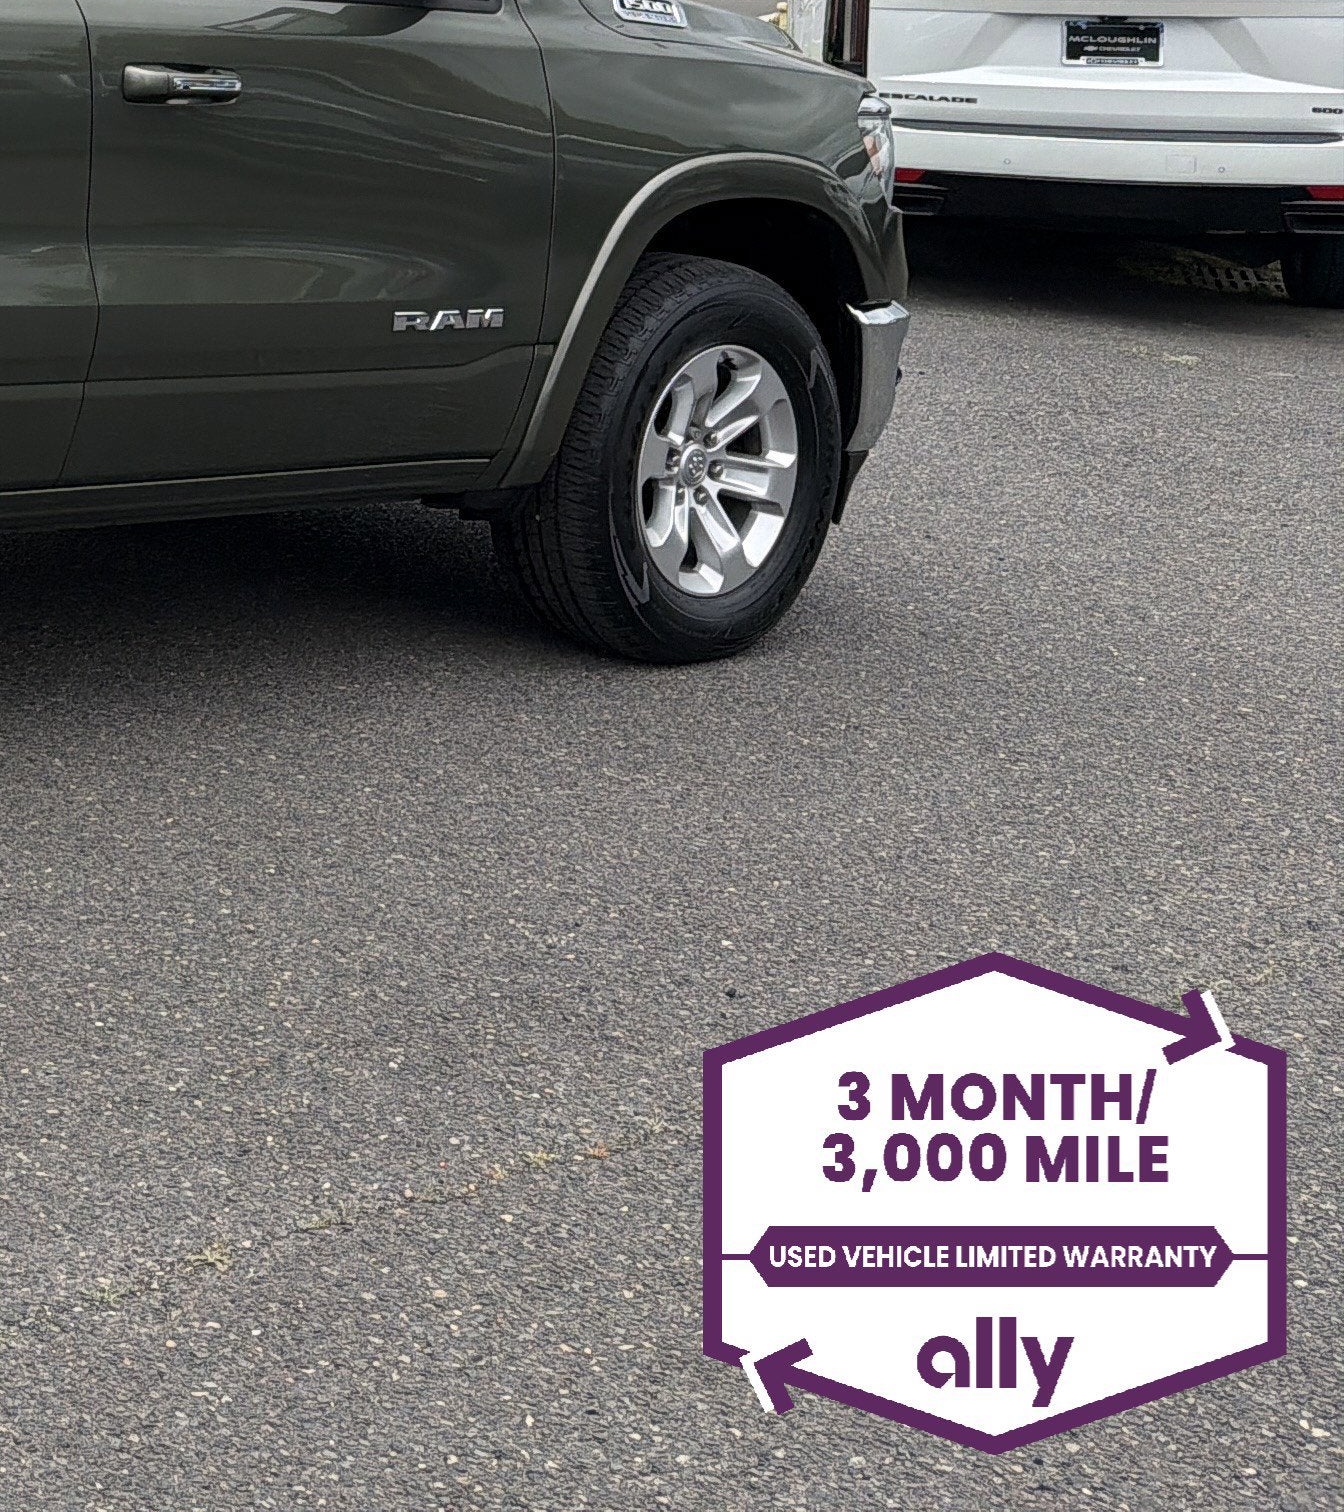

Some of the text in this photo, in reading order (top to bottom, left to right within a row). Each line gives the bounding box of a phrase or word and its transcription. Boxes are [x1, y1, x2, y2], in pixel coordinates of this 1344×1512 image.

[1069, 35, 1157, 44] MCLOUGHLIN
[878, 92, 978, 104] ESCALADE
[393, 308, 505, 332] RAM
